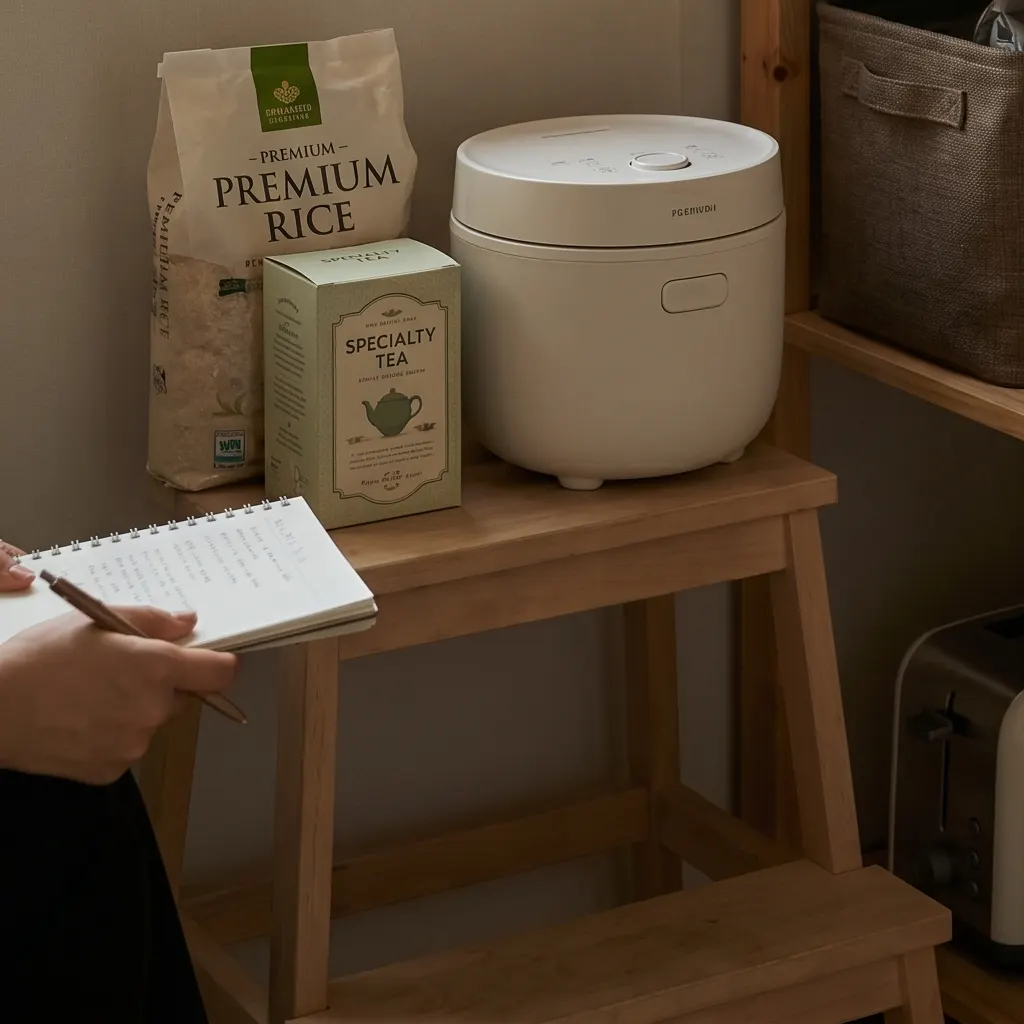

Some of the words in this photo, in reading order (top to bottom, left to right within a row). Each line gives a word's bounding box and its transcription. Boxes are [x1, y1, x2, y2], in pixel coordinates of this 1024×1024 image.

[260, 142, 335, 163] PREMIUM
[213, 154, 400, 208] PREMIUM
[264, 201, 356, 243] RICE
[345, 326, 437, 355] SPECIALTY
[375, 351, 409, 369] TEA
